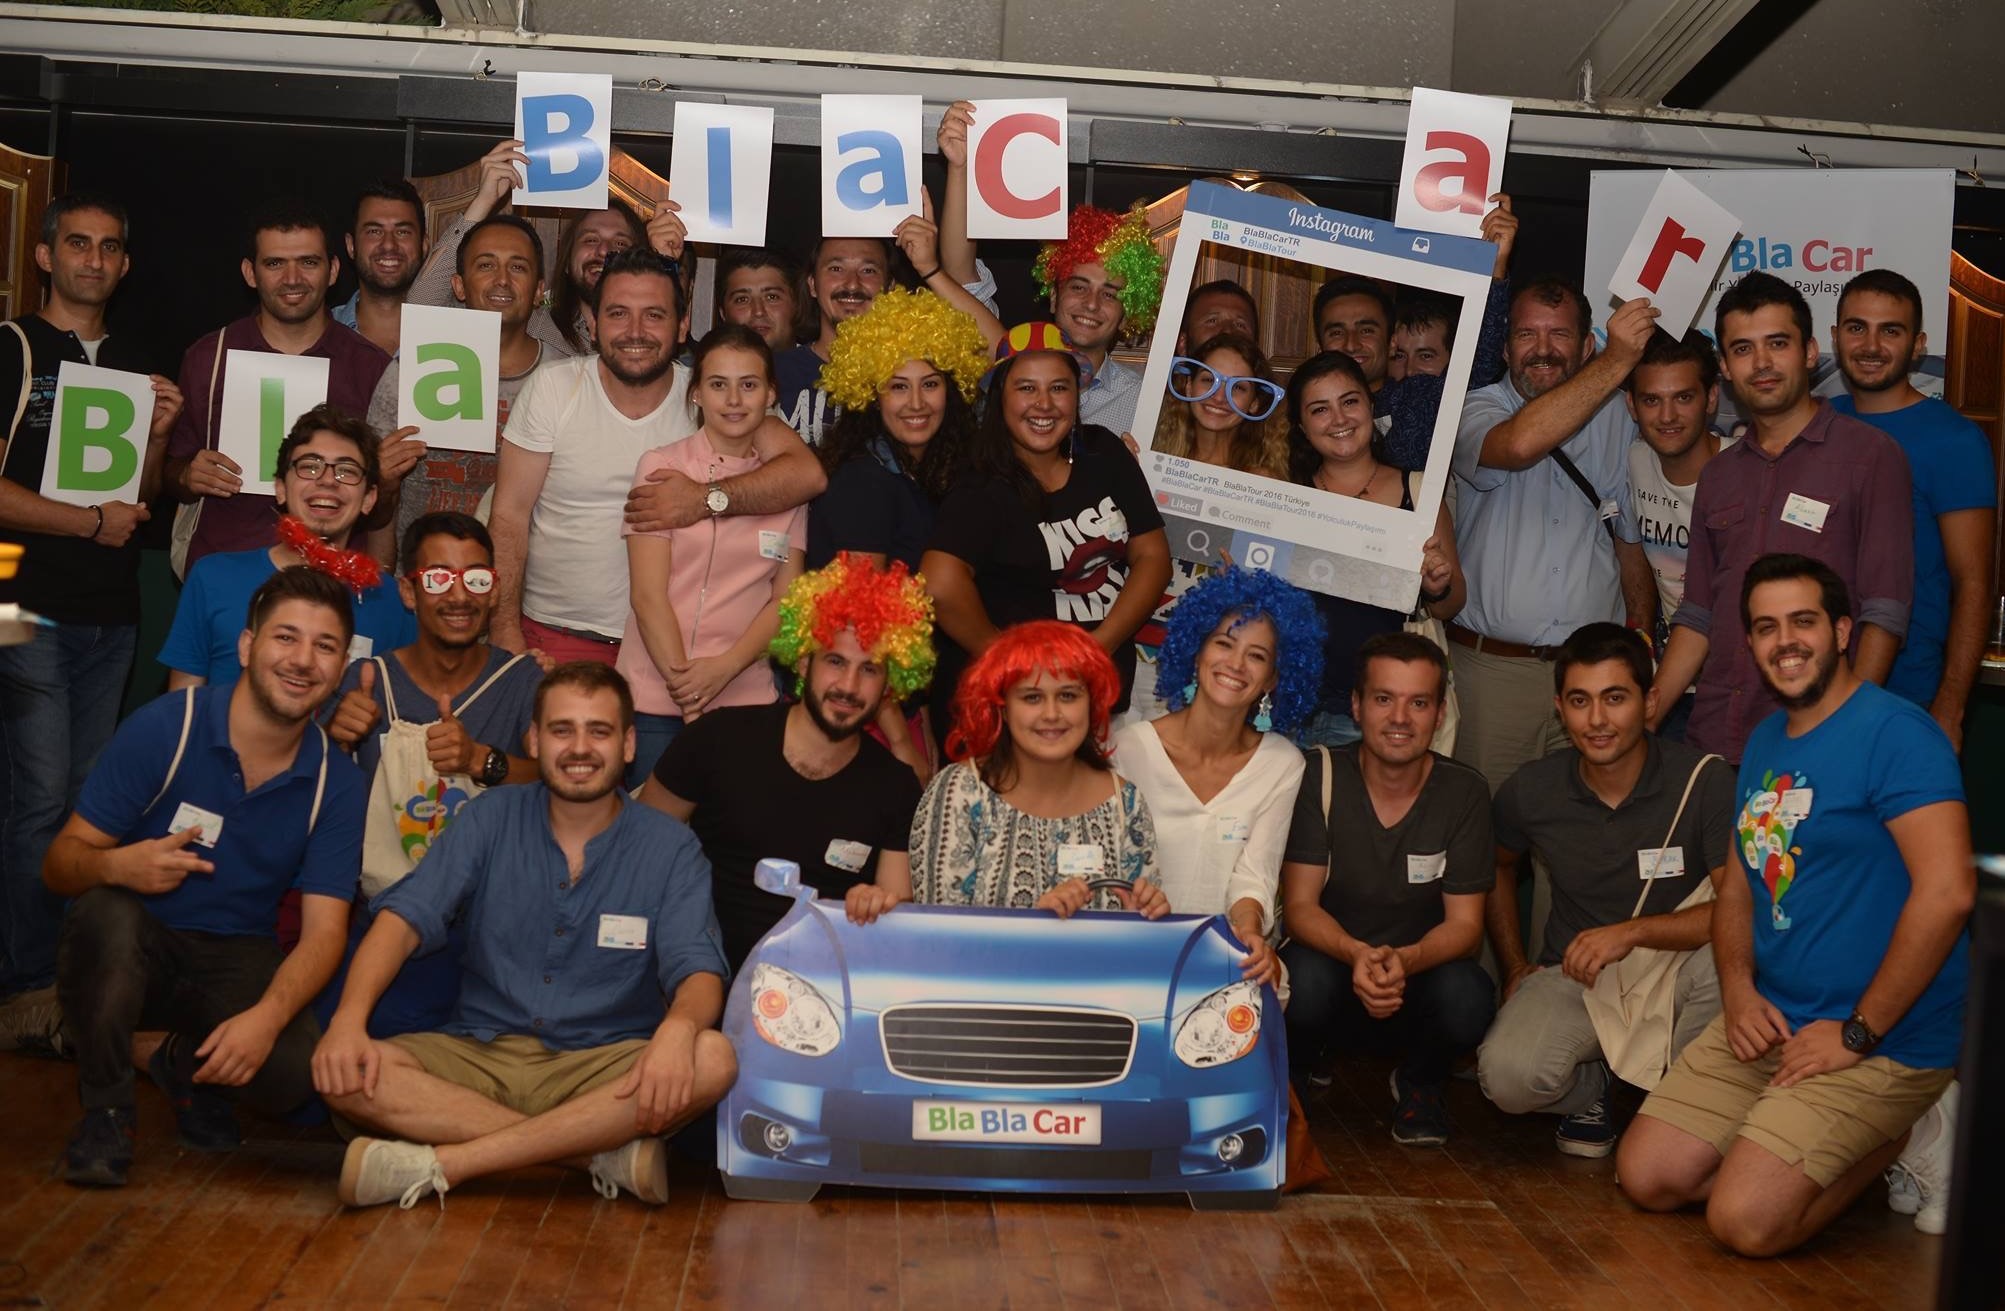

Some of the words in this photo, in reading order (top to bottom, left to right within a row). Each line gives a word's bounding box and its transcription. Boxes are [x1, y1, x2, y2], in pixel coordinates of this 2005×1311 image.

[1211, 218, 1229, 231] Bla
[1288, 207, 1375, 242] Instagram
[1212, 231, 1230, 242] Bla
[1243, 227, 1301, 247] BlaBlaCarTR
[1248, 239, 1297, 257] BlaBlaTour
[1637, 216, 1706, 295] r
[1731, 236, 1793, 273] Bla
[1802, 239, 1873, 273] Car
[1168, 458, 1190, 468] 1.050
[1165, 467, 1219, 486] BlaBlaCarTR
[1223, 480, 1262, 496] BlaBlaTour
[1263, 489, 1282, 501] 2016
[1171, 499, 1198, 513] Liked
[1638, 489, 1658, 505] SAVE
[1662, 496, 1680, 510] THE
[1222, 510, 1272, 530] Comment
[928, 1106, 975, 1132] Bla
[981, 1108, 1027, 1134] Bla
[1033, 1109, 1086, 1135] Car
